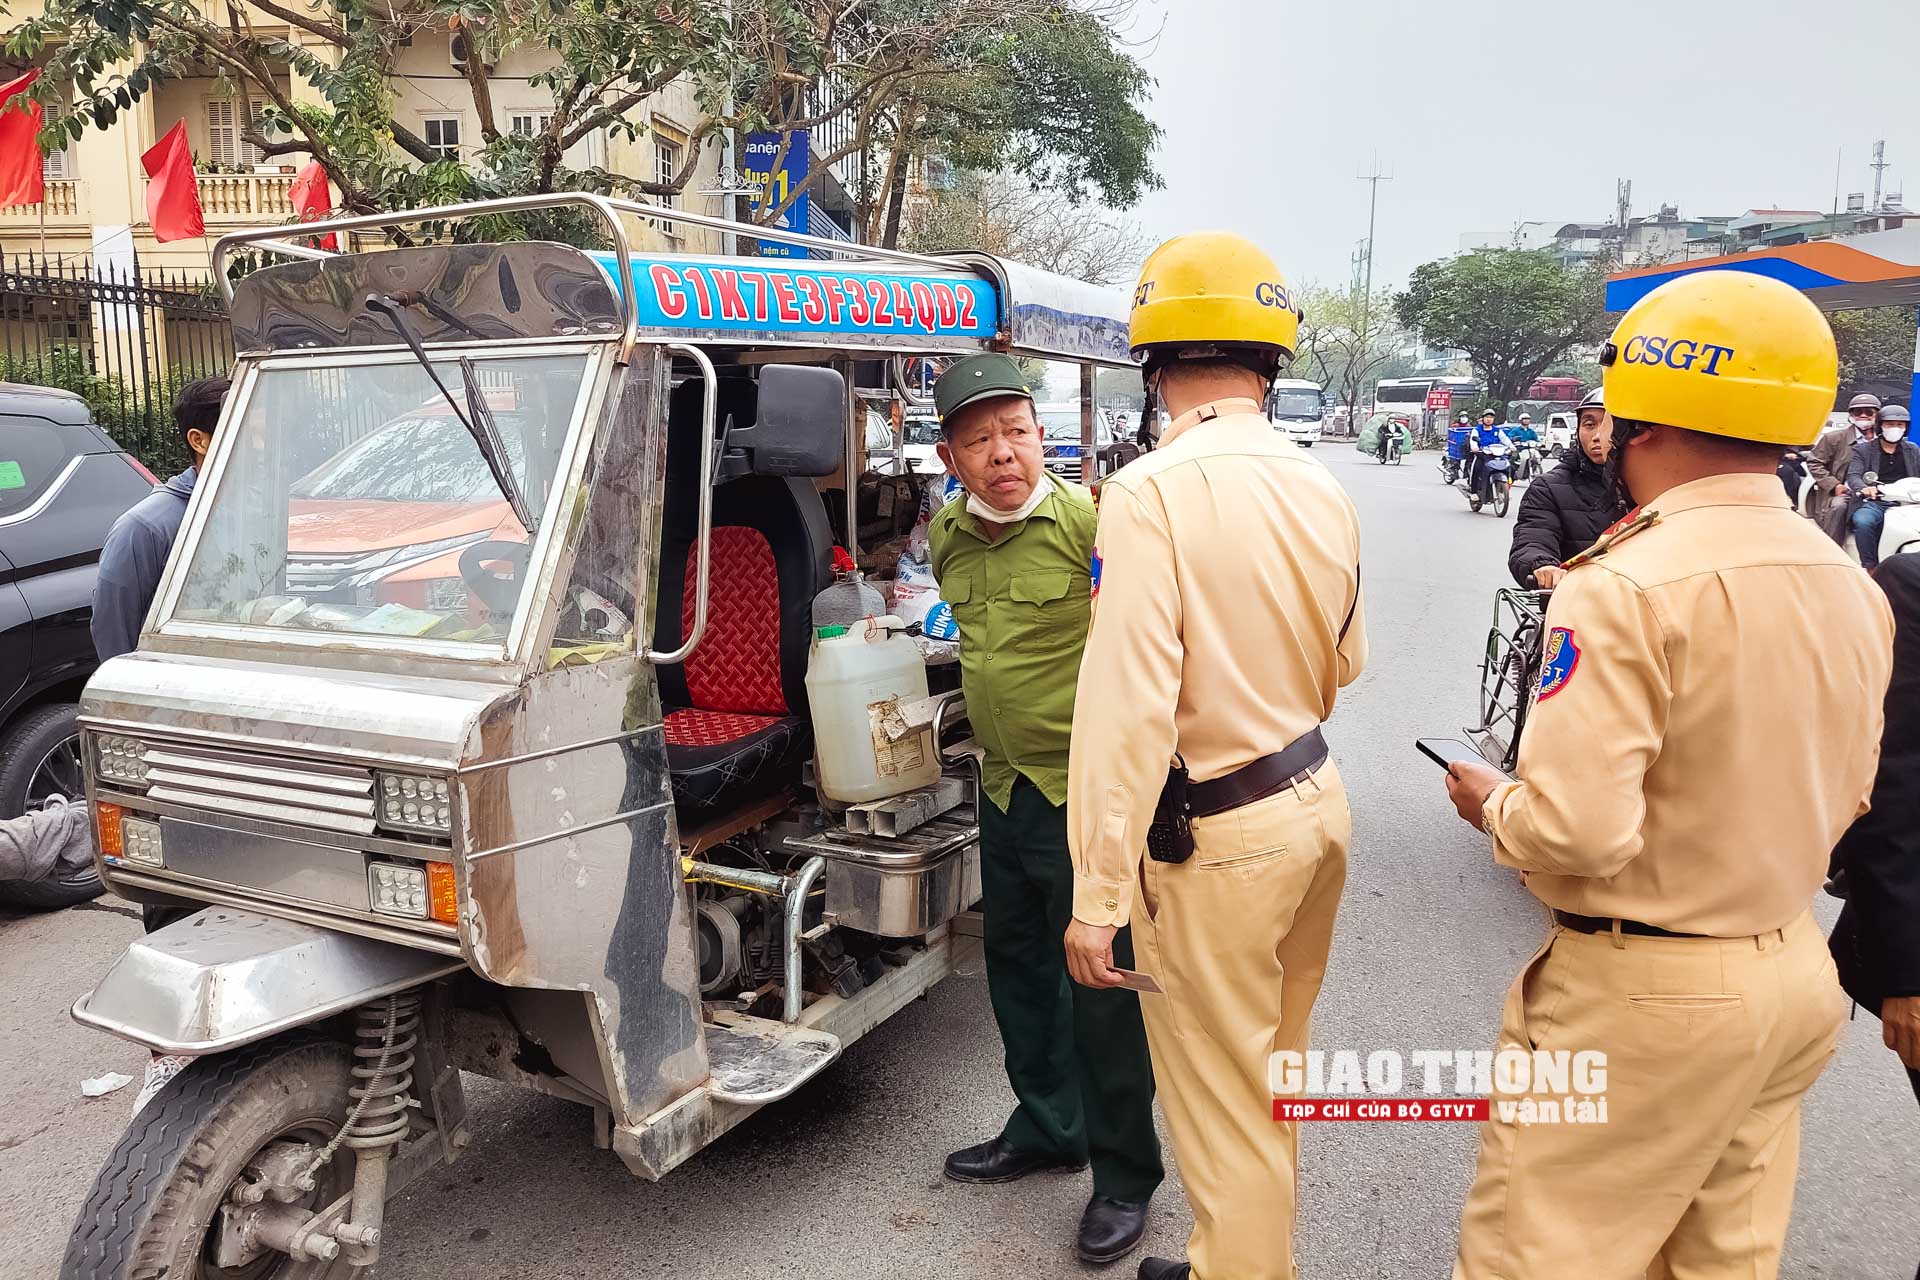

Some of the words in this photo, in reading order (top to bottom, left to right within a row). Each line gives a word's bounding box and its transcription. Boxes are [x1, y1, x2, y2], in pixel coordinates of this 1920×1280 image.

[763, 246, 779, 257] nệm
[780, 246, 789, 256] cũ
[1623, 335, 1735, 377] CSGT
